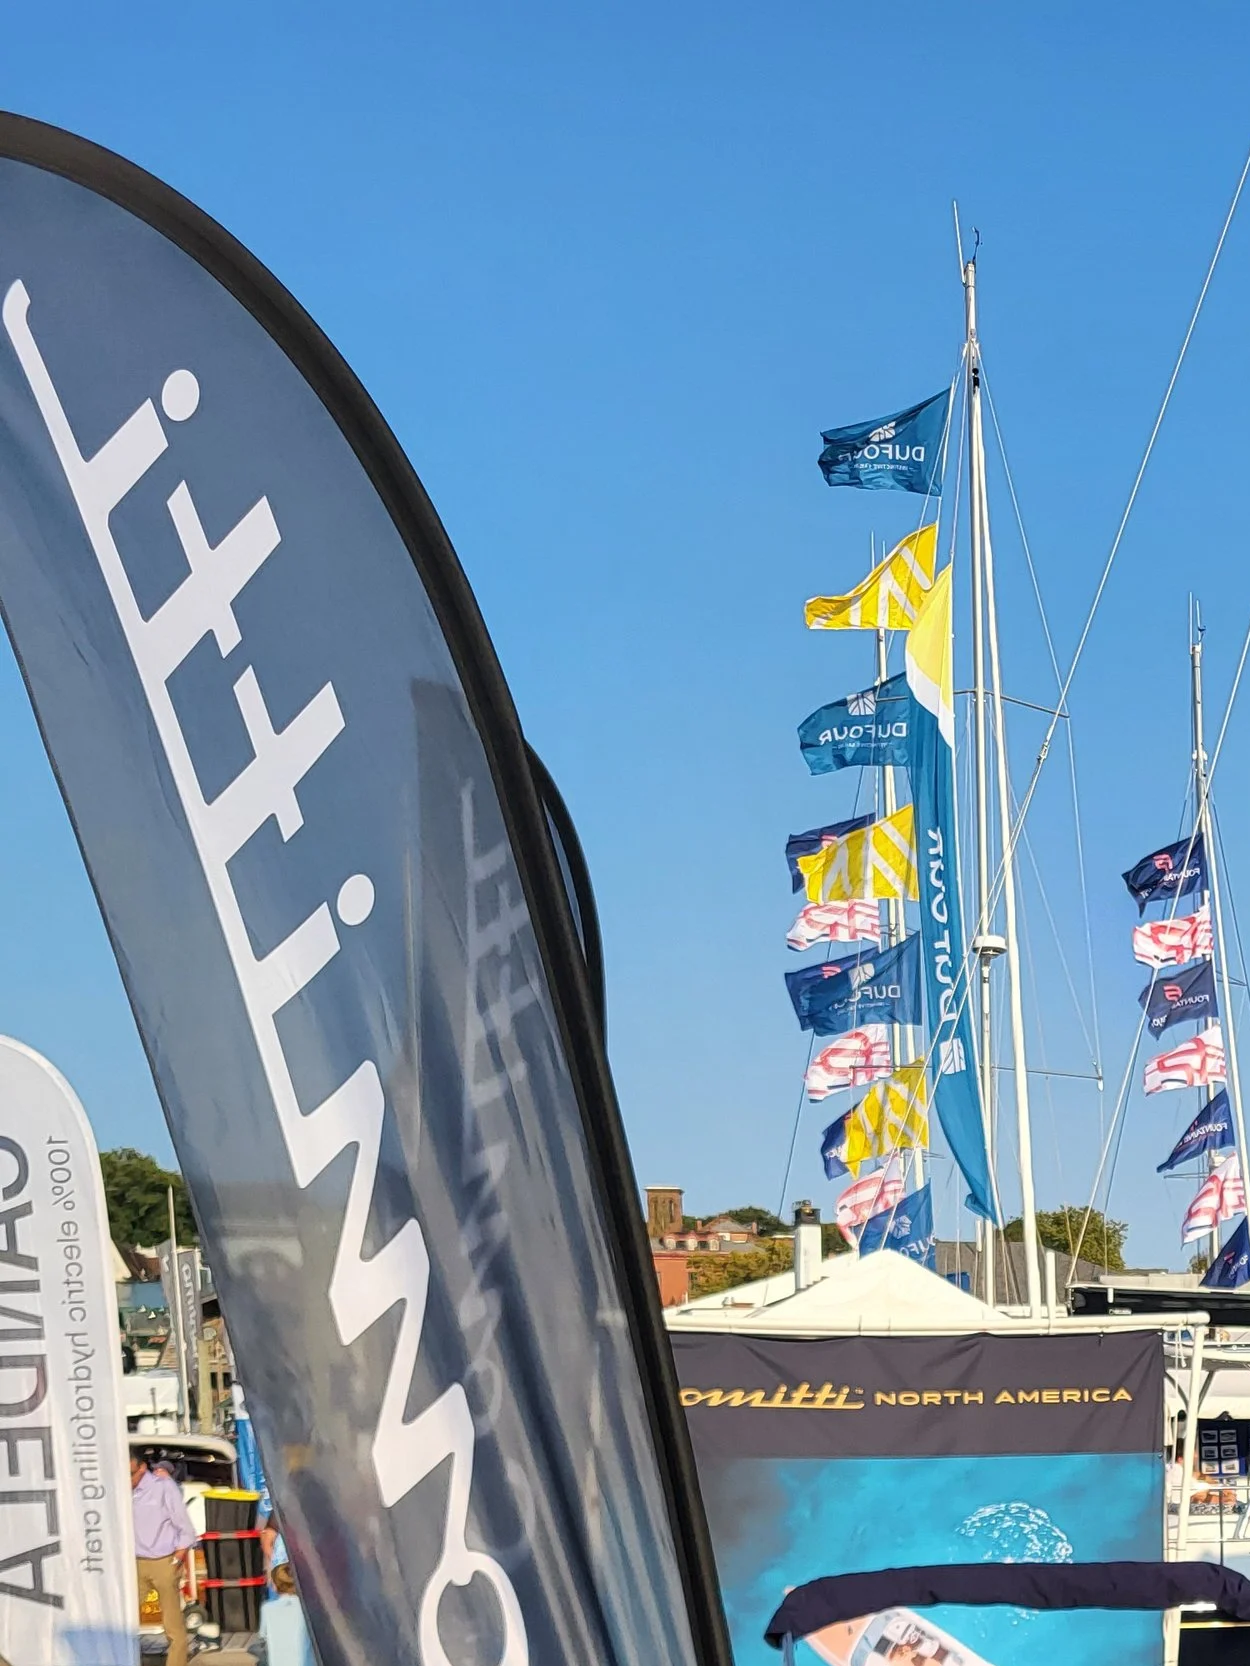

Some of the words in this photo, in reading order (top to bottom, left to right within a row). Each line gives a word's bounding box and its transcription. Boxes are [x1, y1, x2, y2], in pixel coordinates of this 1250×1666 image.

[679, 1380, 866, 1411] omitti
[874, 1390, 984, 1406] NORTH
[994, 1386, 1134, 1406] AMERICA
